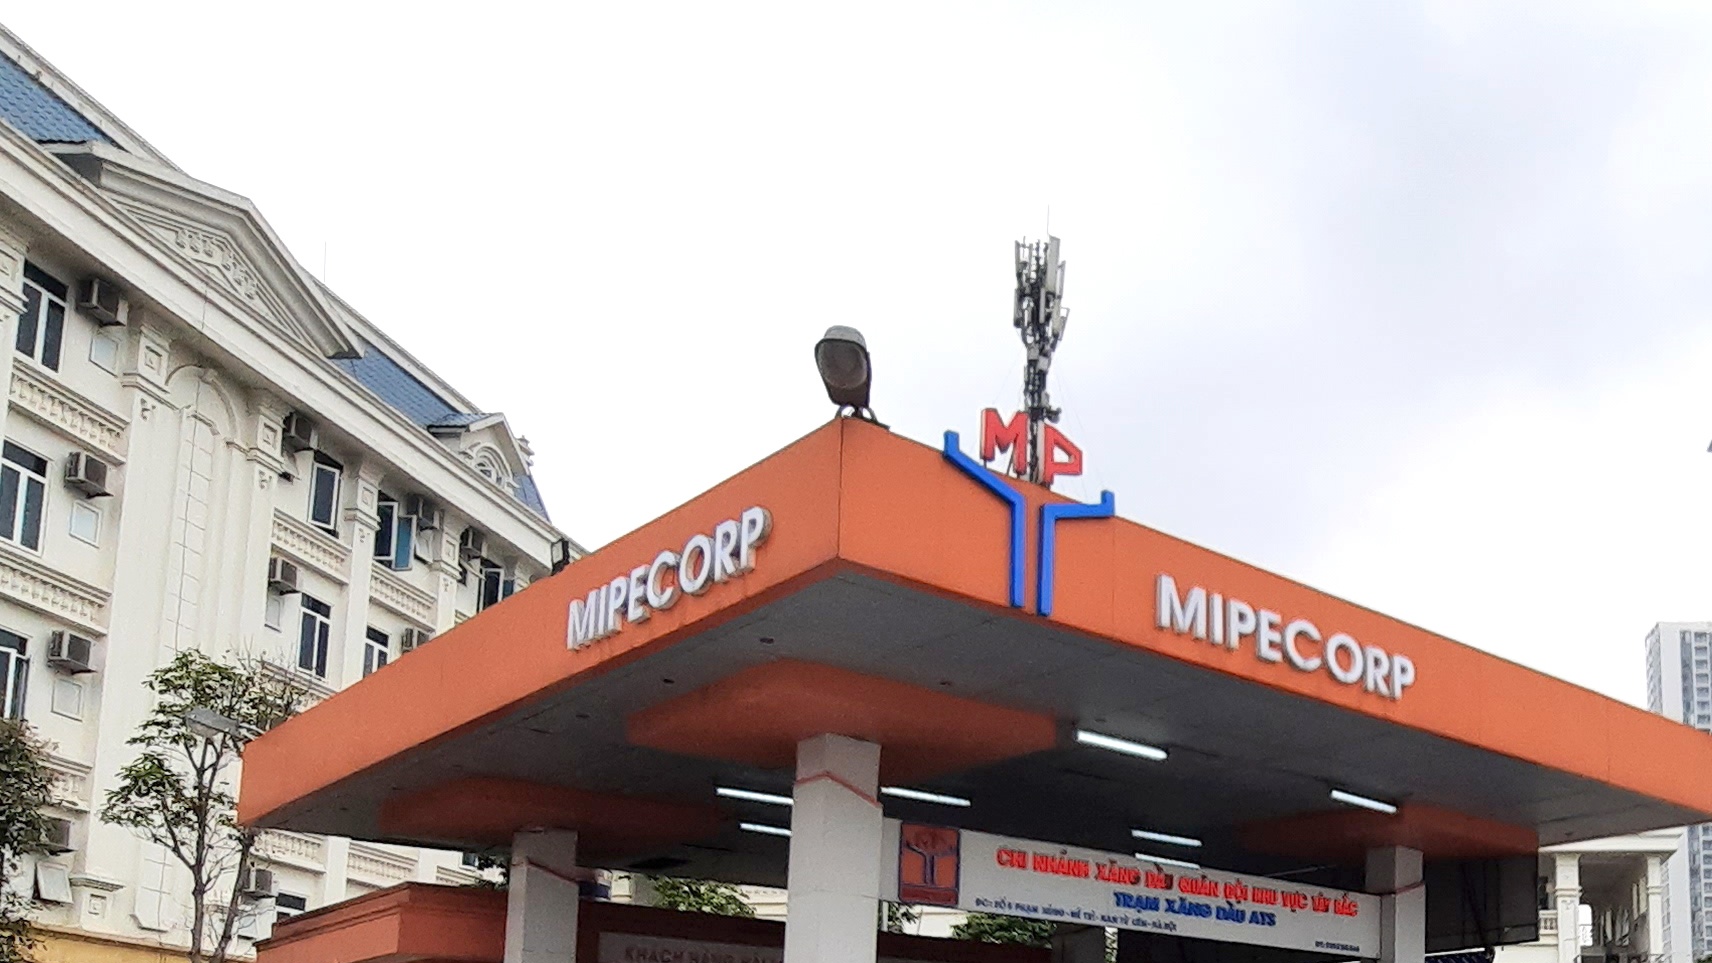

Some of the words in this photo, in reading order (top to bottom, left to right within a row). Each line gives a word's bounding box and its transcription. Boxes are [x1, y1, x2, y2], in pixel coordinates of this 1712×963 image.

[567, 506, 773, 651] MIPECORP
[1156, 573, 1416, 700] MIPECORP
[997, 848, 1027, 868] CHI
